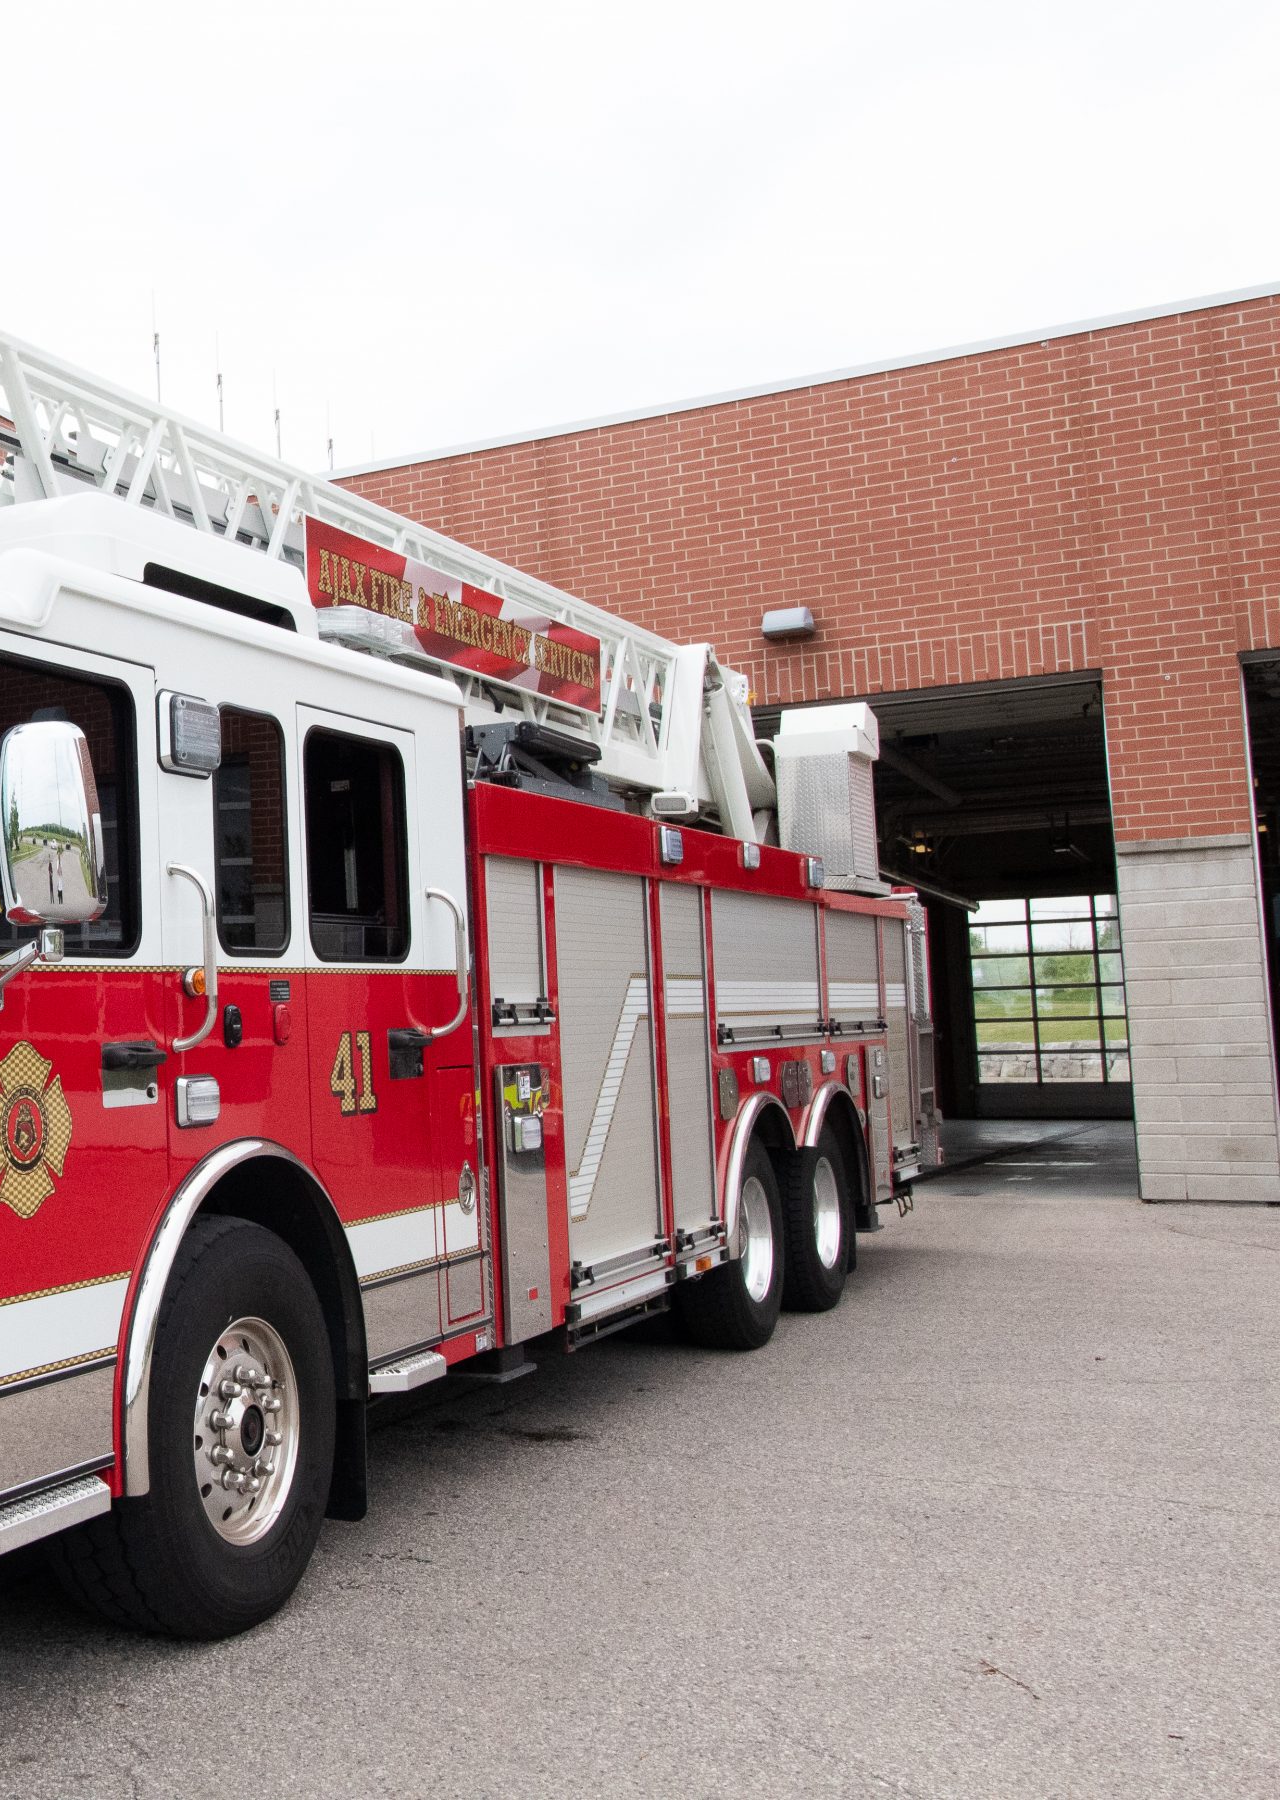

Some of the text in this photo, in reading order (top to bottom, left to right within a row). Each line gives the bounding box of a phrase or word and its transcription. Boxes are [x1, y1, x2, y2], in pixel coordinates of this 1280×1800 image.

[318, 547, 596, 690] AJAX FIRE & EMERGENCY SERVICES
[329, 1030, 378, 1118] 41
